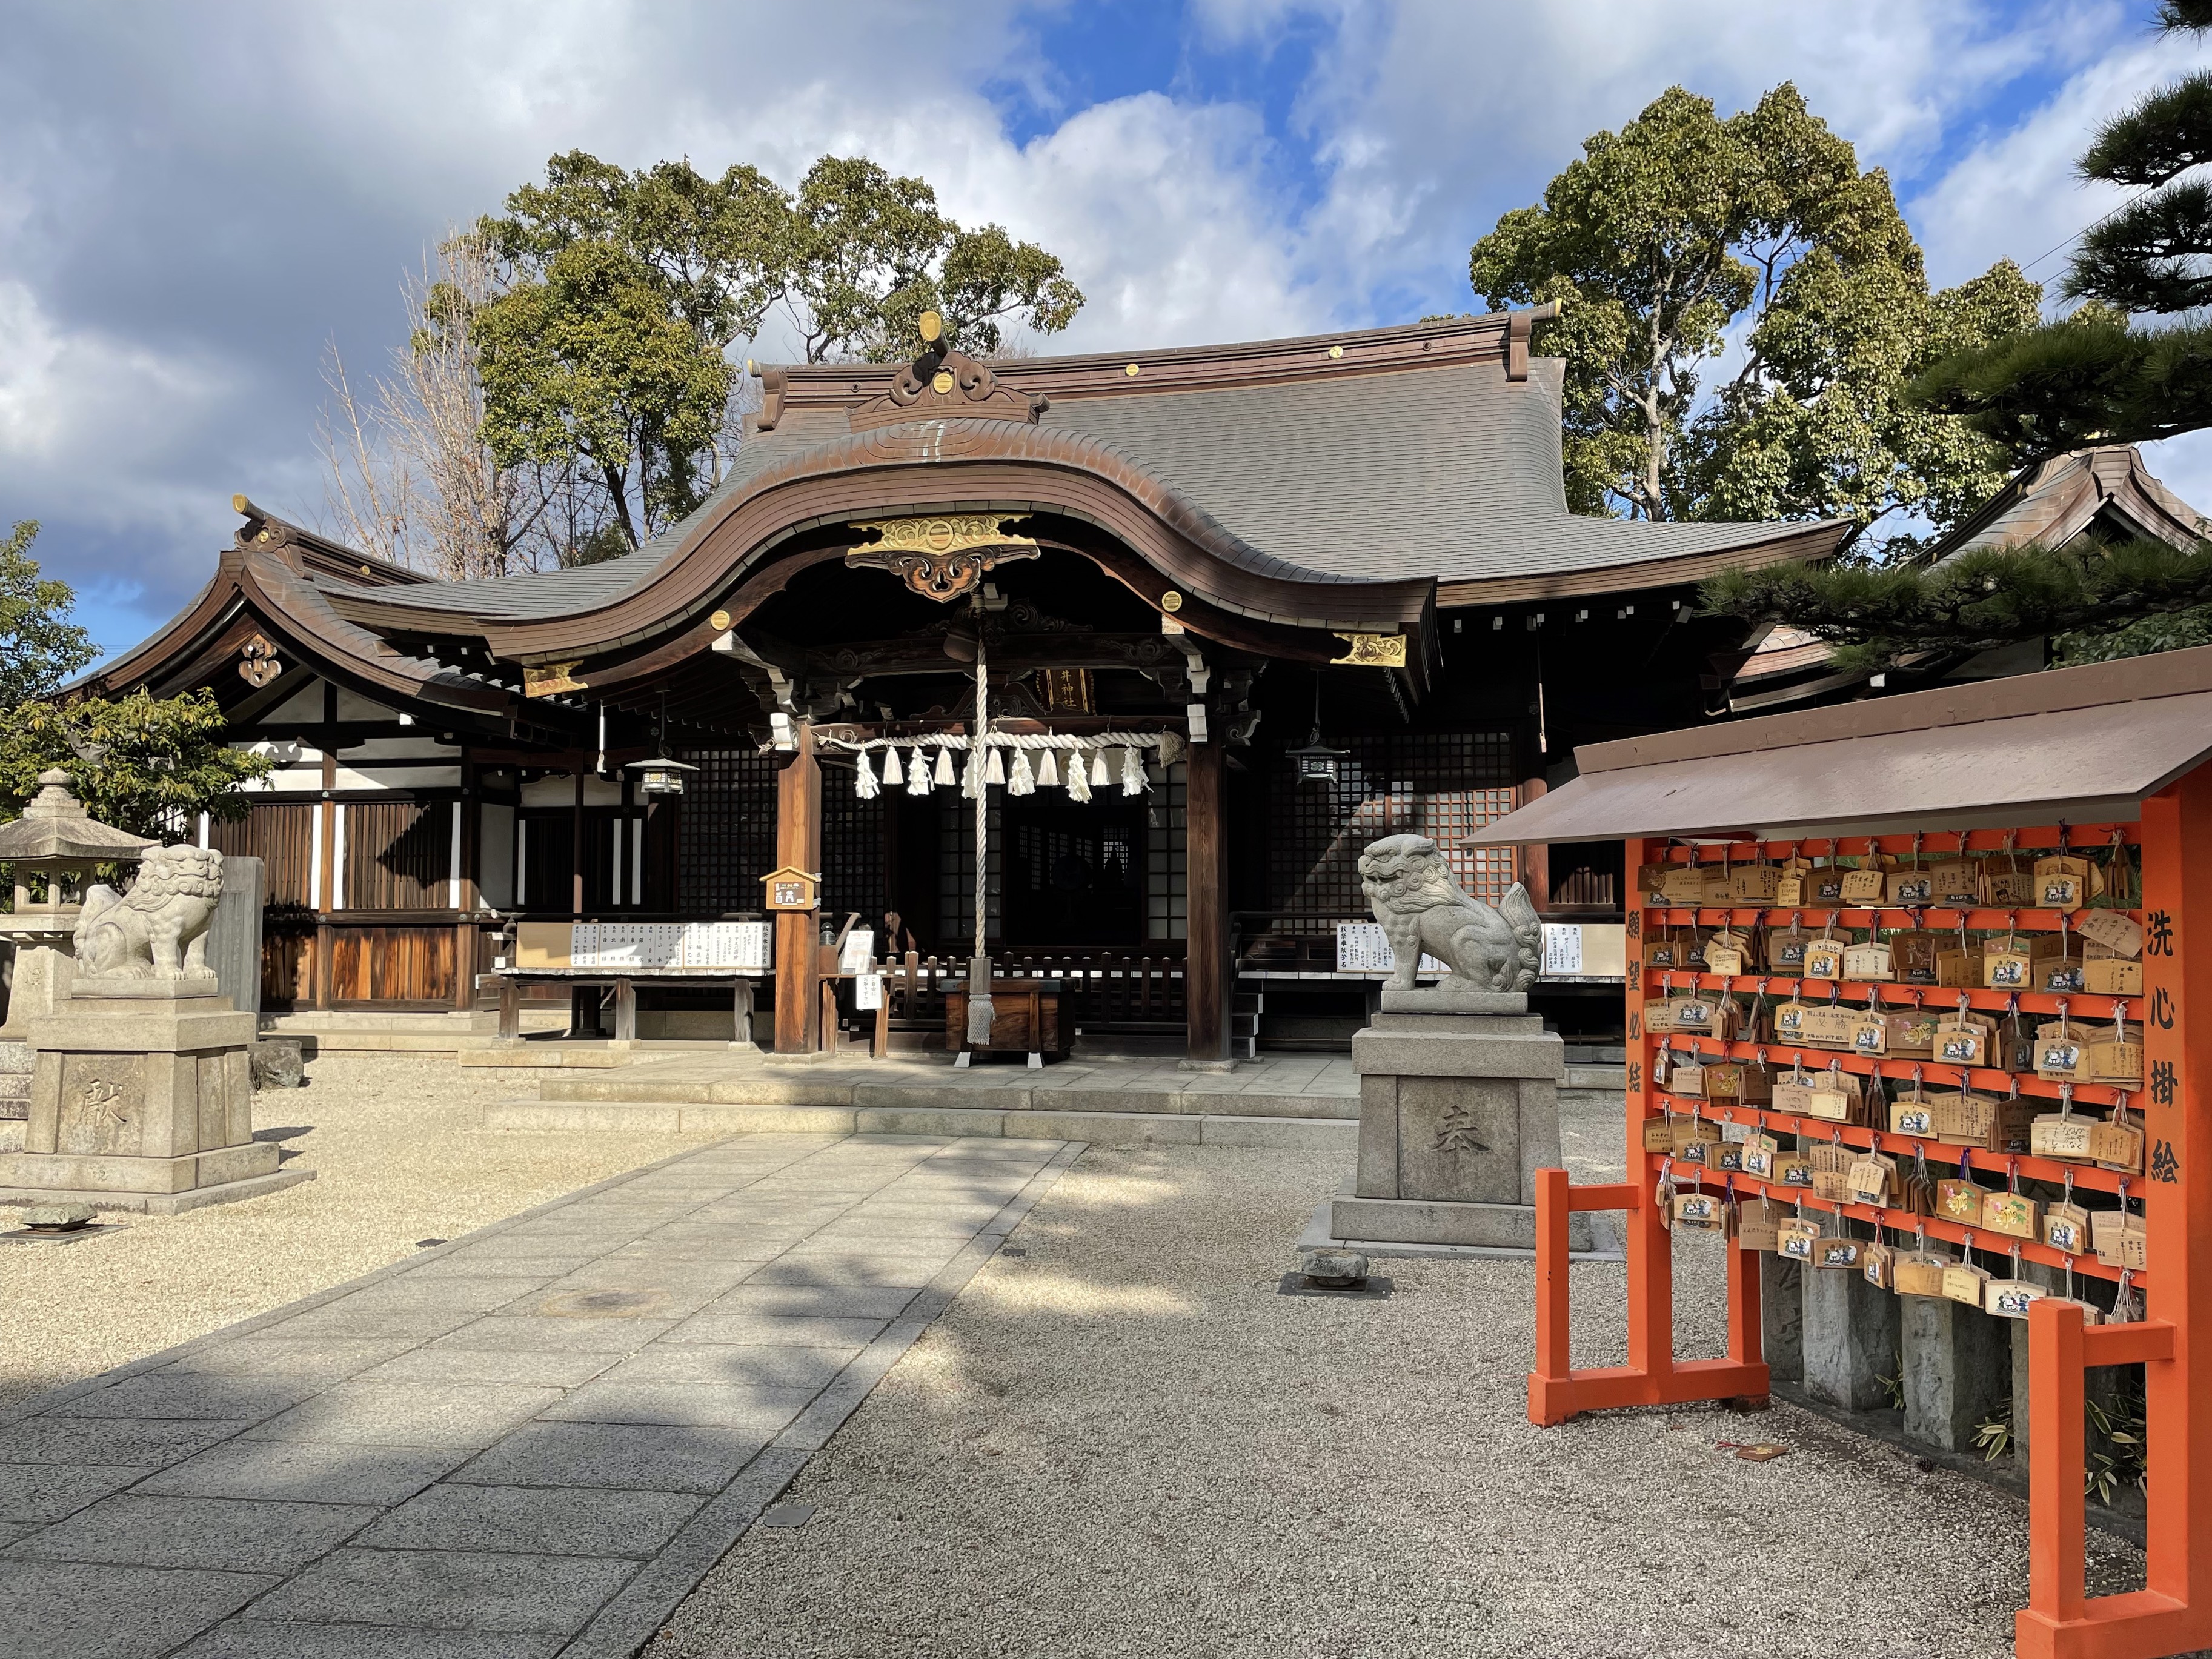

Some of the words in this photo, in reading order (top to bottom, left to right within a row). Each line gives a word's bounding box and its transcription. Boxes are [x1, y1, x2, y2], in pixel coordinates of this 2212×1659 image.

[1626, 910, 1642, 1093] 願望必結
[1430, 1104, 1492, 1171] 奉
